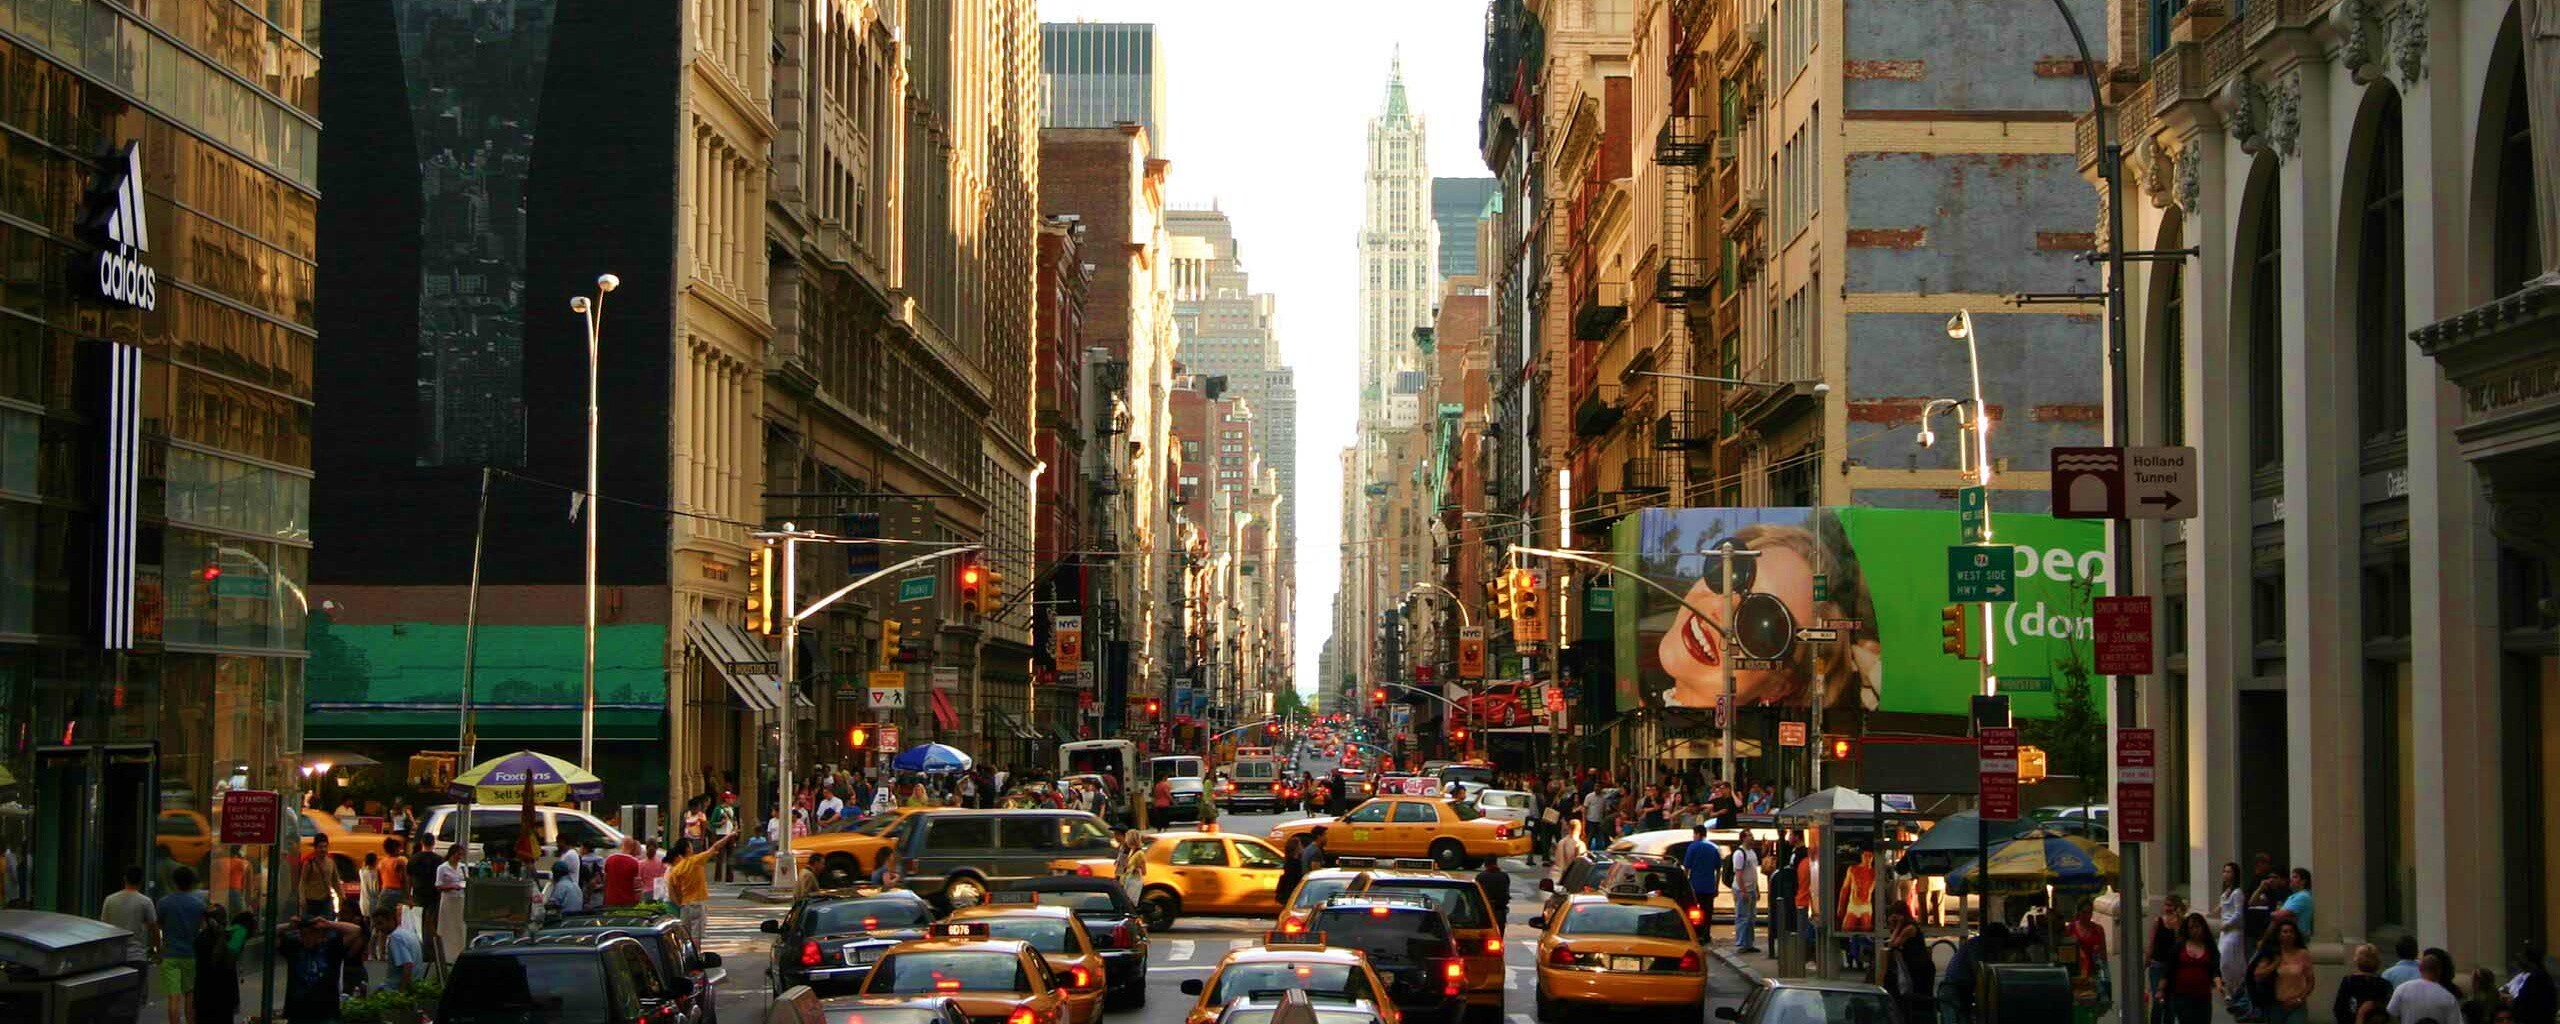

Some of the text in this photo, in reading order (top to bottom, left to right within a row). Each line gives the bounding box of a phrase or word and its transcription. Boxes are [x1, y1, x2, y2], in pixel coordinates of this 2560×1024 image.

[101, 243, 156, 311] adidas
[2133, 456, 2185, 467] Holland
[2134, 472, 2178, 483] Tunnel
[1957, 570, 2006, 580] WEST SIDE
[1957, 586, 1977, 595] HWY
[2096, 601, 2150, 613] SNOW ROUTE
[1059, 620, 1079, 628] NYC
[1463, 628, 1482, 637] NYC
[2096, 631, 2149, 643] NO STANDING
[736, 665, 766, 674] HOUSTON
[768, 665, 776, 674] ST
[1079, 672, 1092, 681] 30
[494, 790, 512, 800] Sell
